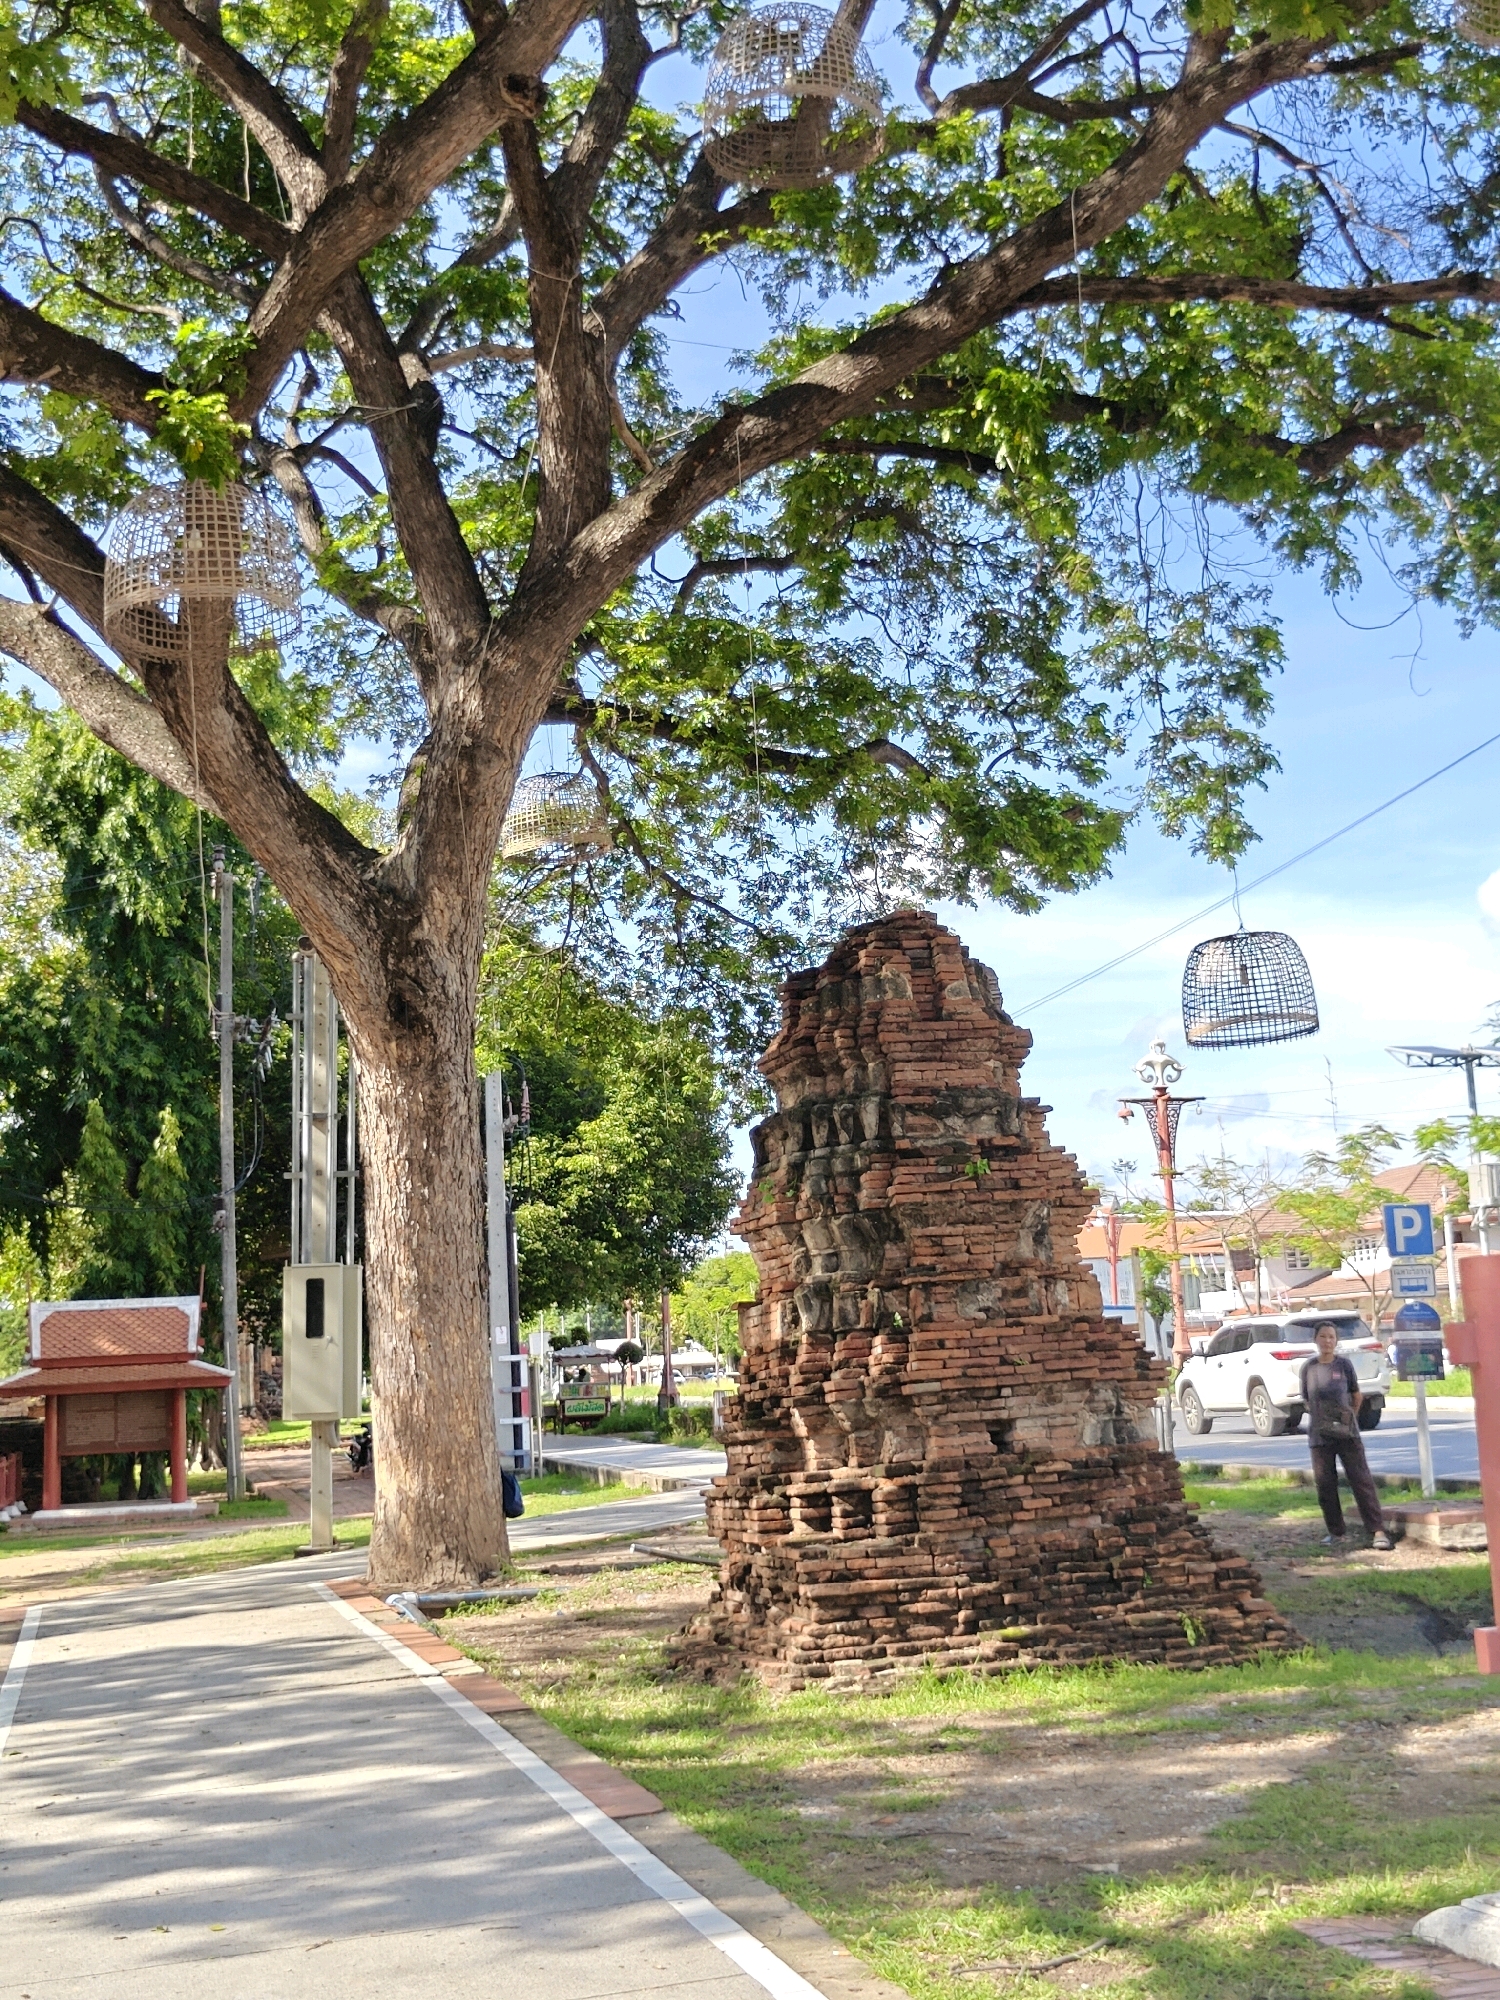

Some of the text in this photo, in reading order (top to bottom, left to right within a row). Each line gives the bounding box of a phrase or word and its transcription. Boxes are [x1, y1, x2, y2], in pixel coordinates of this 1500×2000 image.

[1393, 1208, 1421, 1252] P
[566, 1400, 605, 1412] ผลไม้สด
